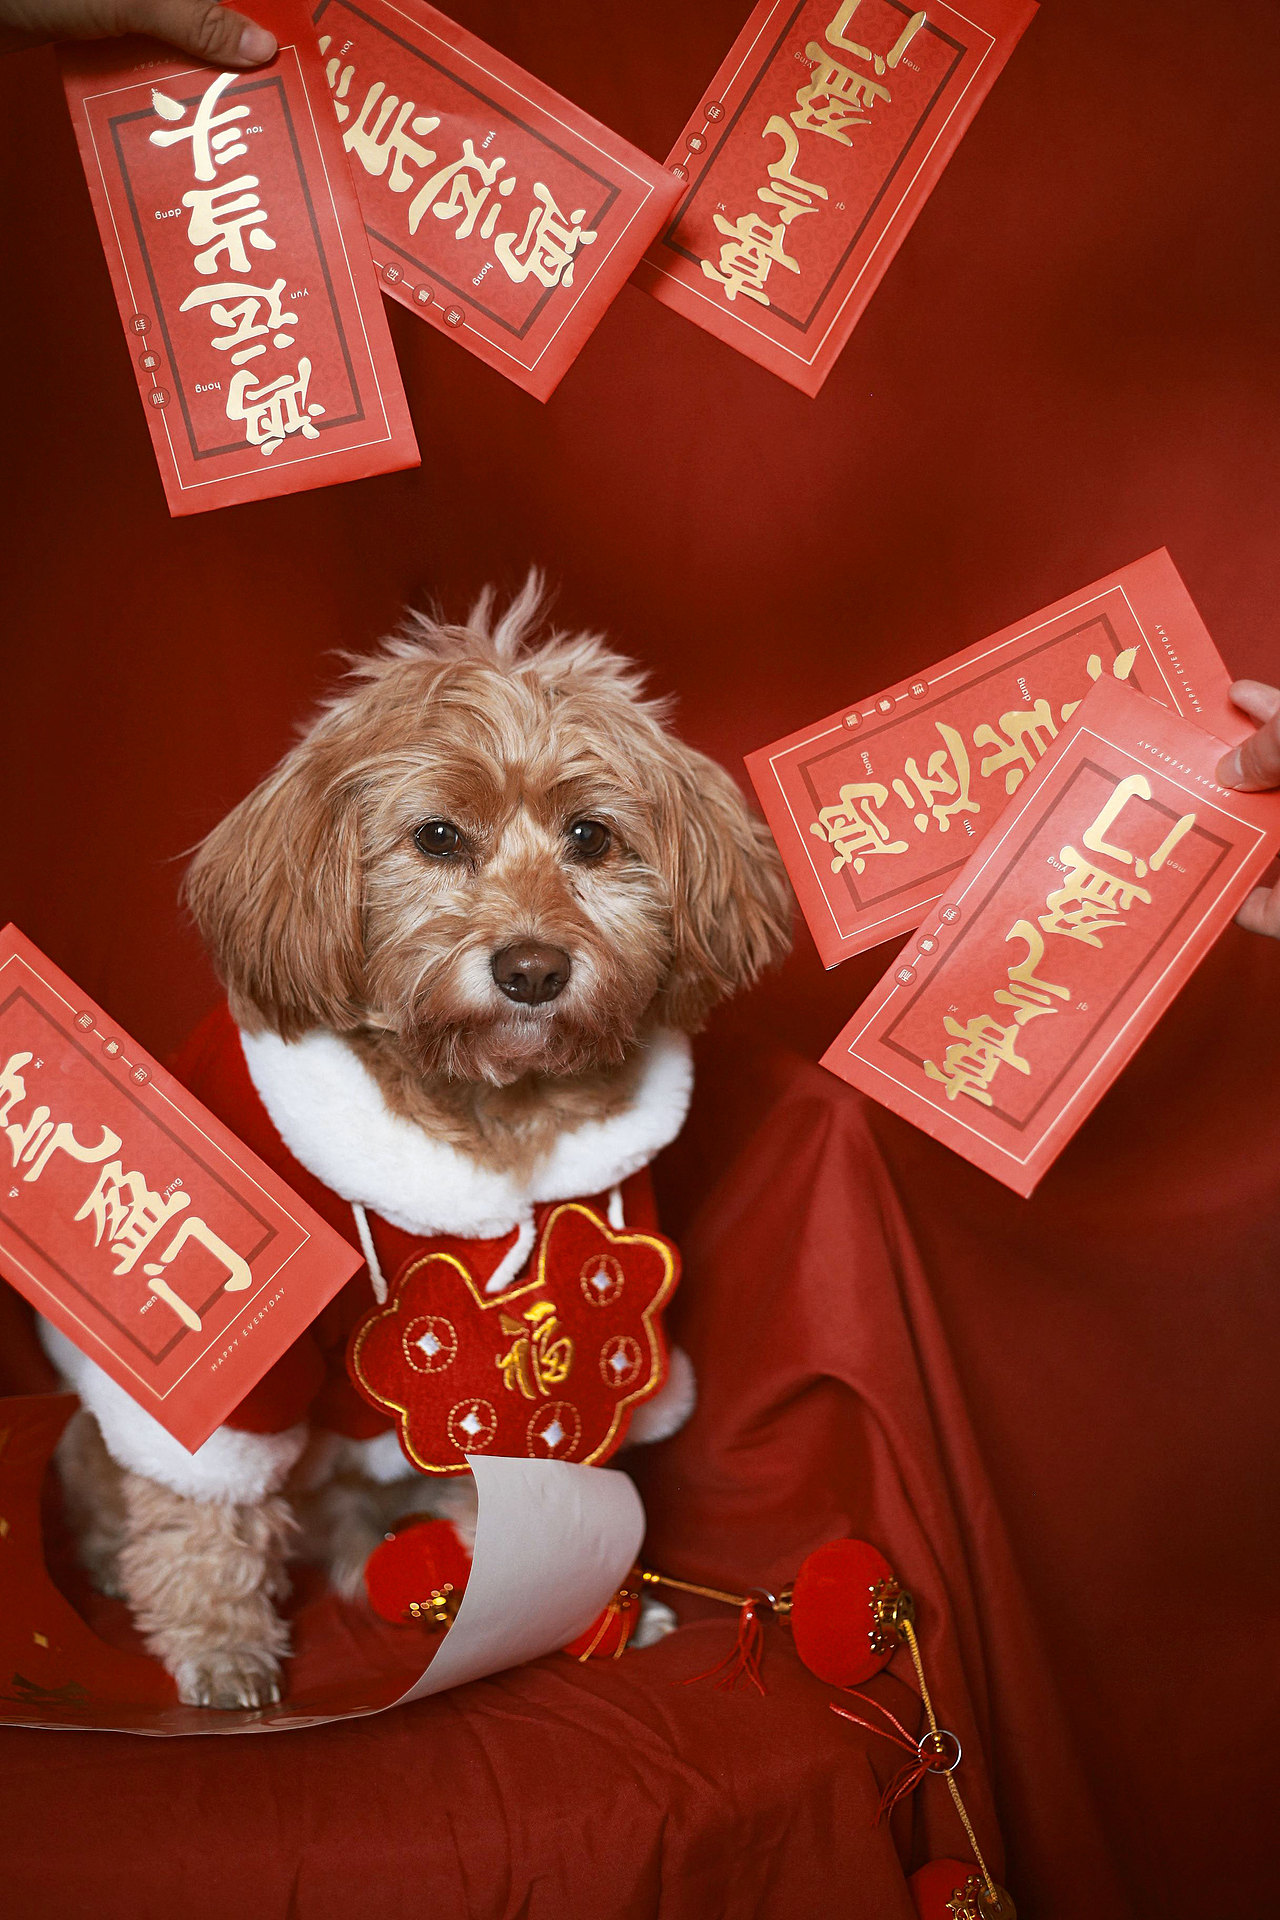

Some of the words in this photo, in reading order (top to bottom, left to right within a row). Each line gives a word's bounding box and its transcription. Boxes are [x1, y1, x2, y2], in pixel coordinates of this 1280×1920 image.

[340, 40, 354, 56] tou
[793, 51, 814, 69] ying
[902, 57, 921, 73] men
[245, 126, 263, 135] tou
[481, 130, 496, 149] yun
[700, 0, 927, 307] 喜气盈门
[154, 207, 182, 220] dang
[716, 202, 727, 212] xi
[834, 201, 846, 211] qi
[149, 72, 327, 456] 鸿运当头
[472, 262, 494, 286] hong
[290, 287, 309, 300] yun
[194, 381, 221, 393] hong
[1154, 624, 1184, 675] EVERYDAY
[1016, 677, 1032, 702] dang
[1181, 681, 1203, 713] HAPPY
[860, 751, 874, 776] hong
[1136, 740, 1192, 775] EVERYDAY
[1195, 775, 1231, 797] HAPPY
[963, 819, 976, 837] yun
[1046, 855, 1069, 873] ying
[1166, 858, 1187, 874] men
[923, 774, 1197, 1107] 喜气盈门
[947, 1004, 959, 1013] xi
[1075, 1002, 1089, 1012] qi
[34, 1057, 45, 1069] xi
[8, 1186, 19, 1198] qi
[163, 1177, 184, 1198] ying
[139, 1294, 158, 1315] men
[211, 1338, 240, 1372] HAPPY
[242, 1287, 286, 1338] EVERYDAY
[495, 1301, 574, 1401] 福
